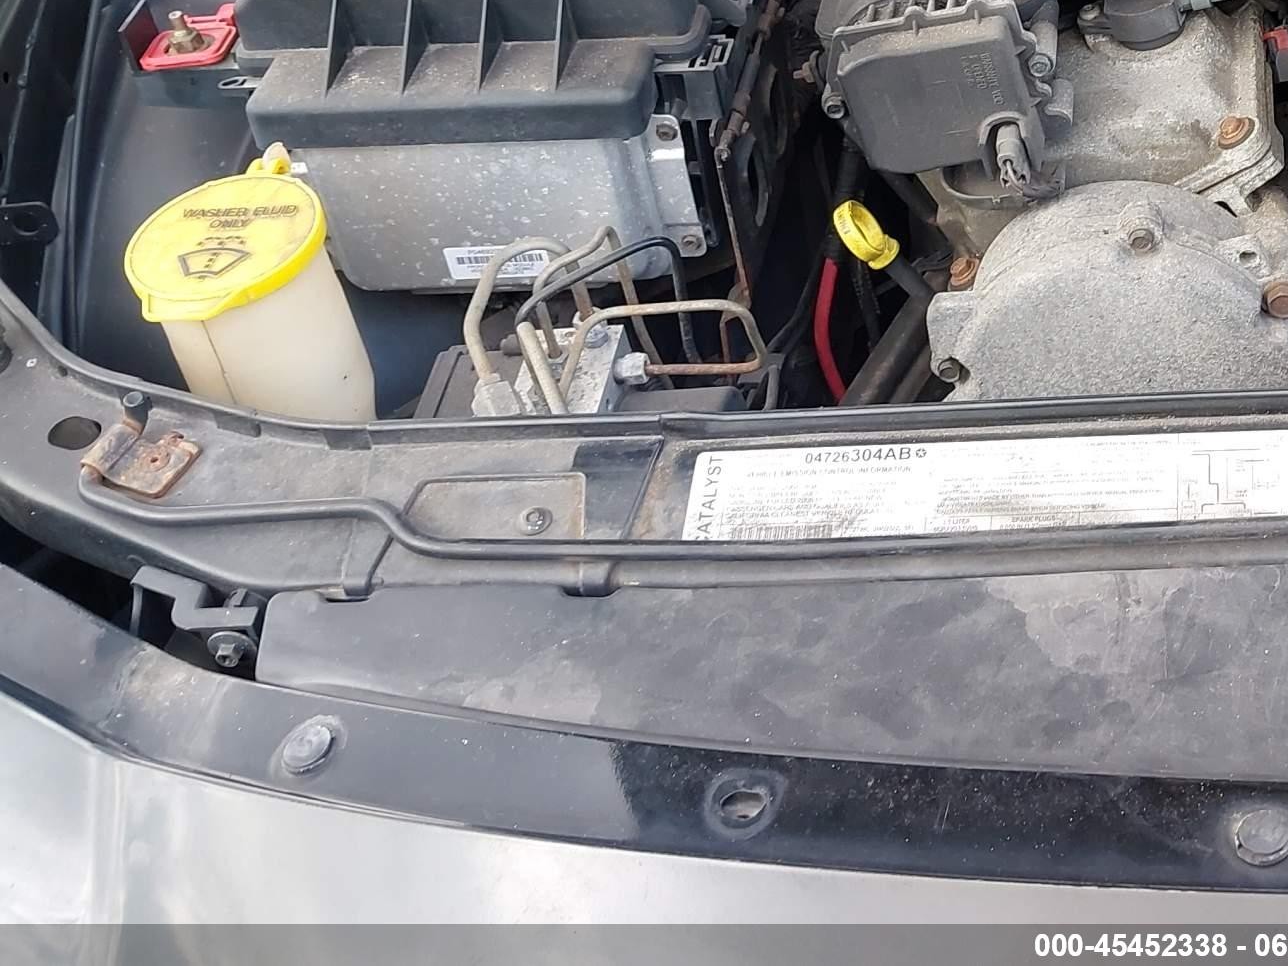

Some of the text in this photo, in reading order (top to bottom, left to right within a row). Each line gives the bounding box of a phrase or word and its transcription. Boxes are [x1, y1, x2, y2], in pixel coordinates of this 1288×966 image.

[183, 205, 299, 218] WASHER FLUID
[209, 219, 254, 229] ONLY
[804, 447, 912, 464] 04726304AB
[857, 465, 912, 474] INFORMATION
